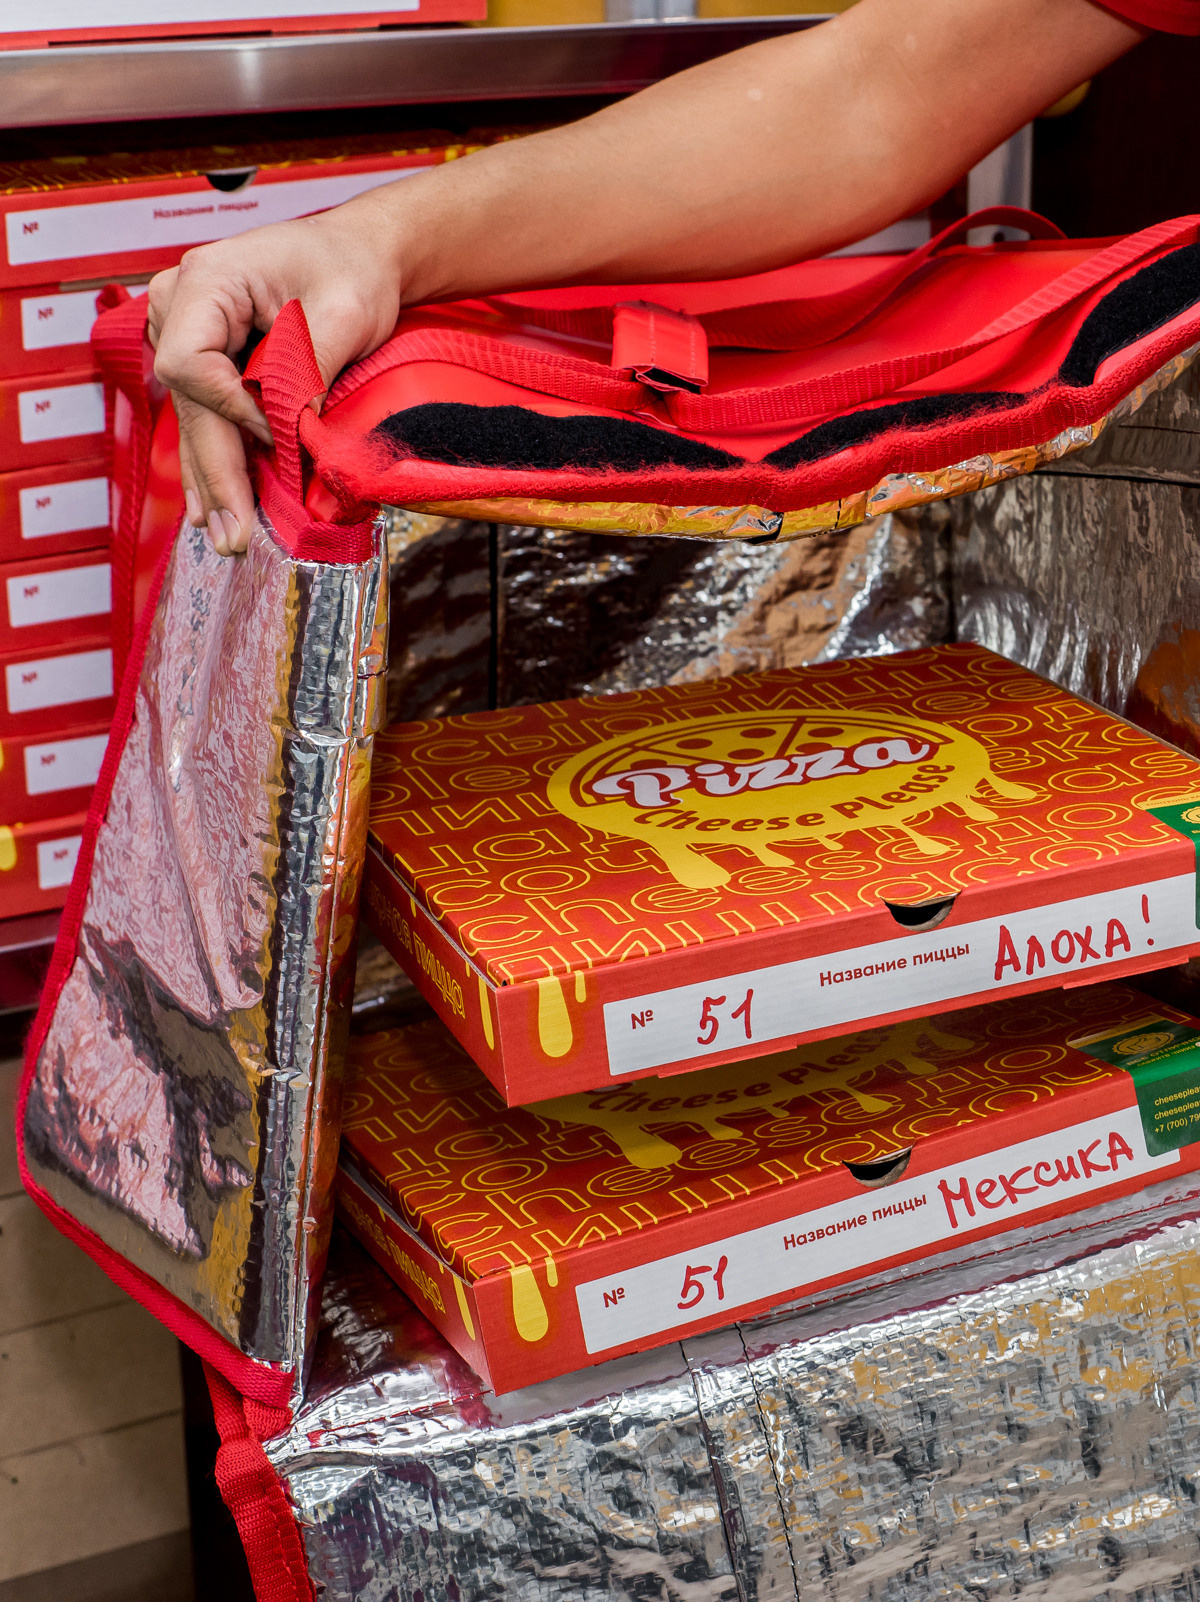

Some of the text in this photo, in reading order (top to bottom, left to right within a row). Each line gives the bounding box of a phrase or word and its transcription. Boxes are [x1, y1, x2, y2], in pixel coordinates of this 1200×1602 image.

[591, 738, 931, 808] Pizza
[632, 763, 956, 832] Cheese Please
[819, 943, 970, 987] Название пиццы
[630, 1008, 655, 1030] №
[695, 988, 754, 1046] 51
[588, 1081, 772, 1112] Cheese
[1154, 1123, 1164, 1133] +7
[1166, 1117, 1188, 1132] (700)
[782, 1194, 928, 1251] Название пиццы
[602, 1286, 626, 1308] №
[676, 1254, 730, 1310] 51
